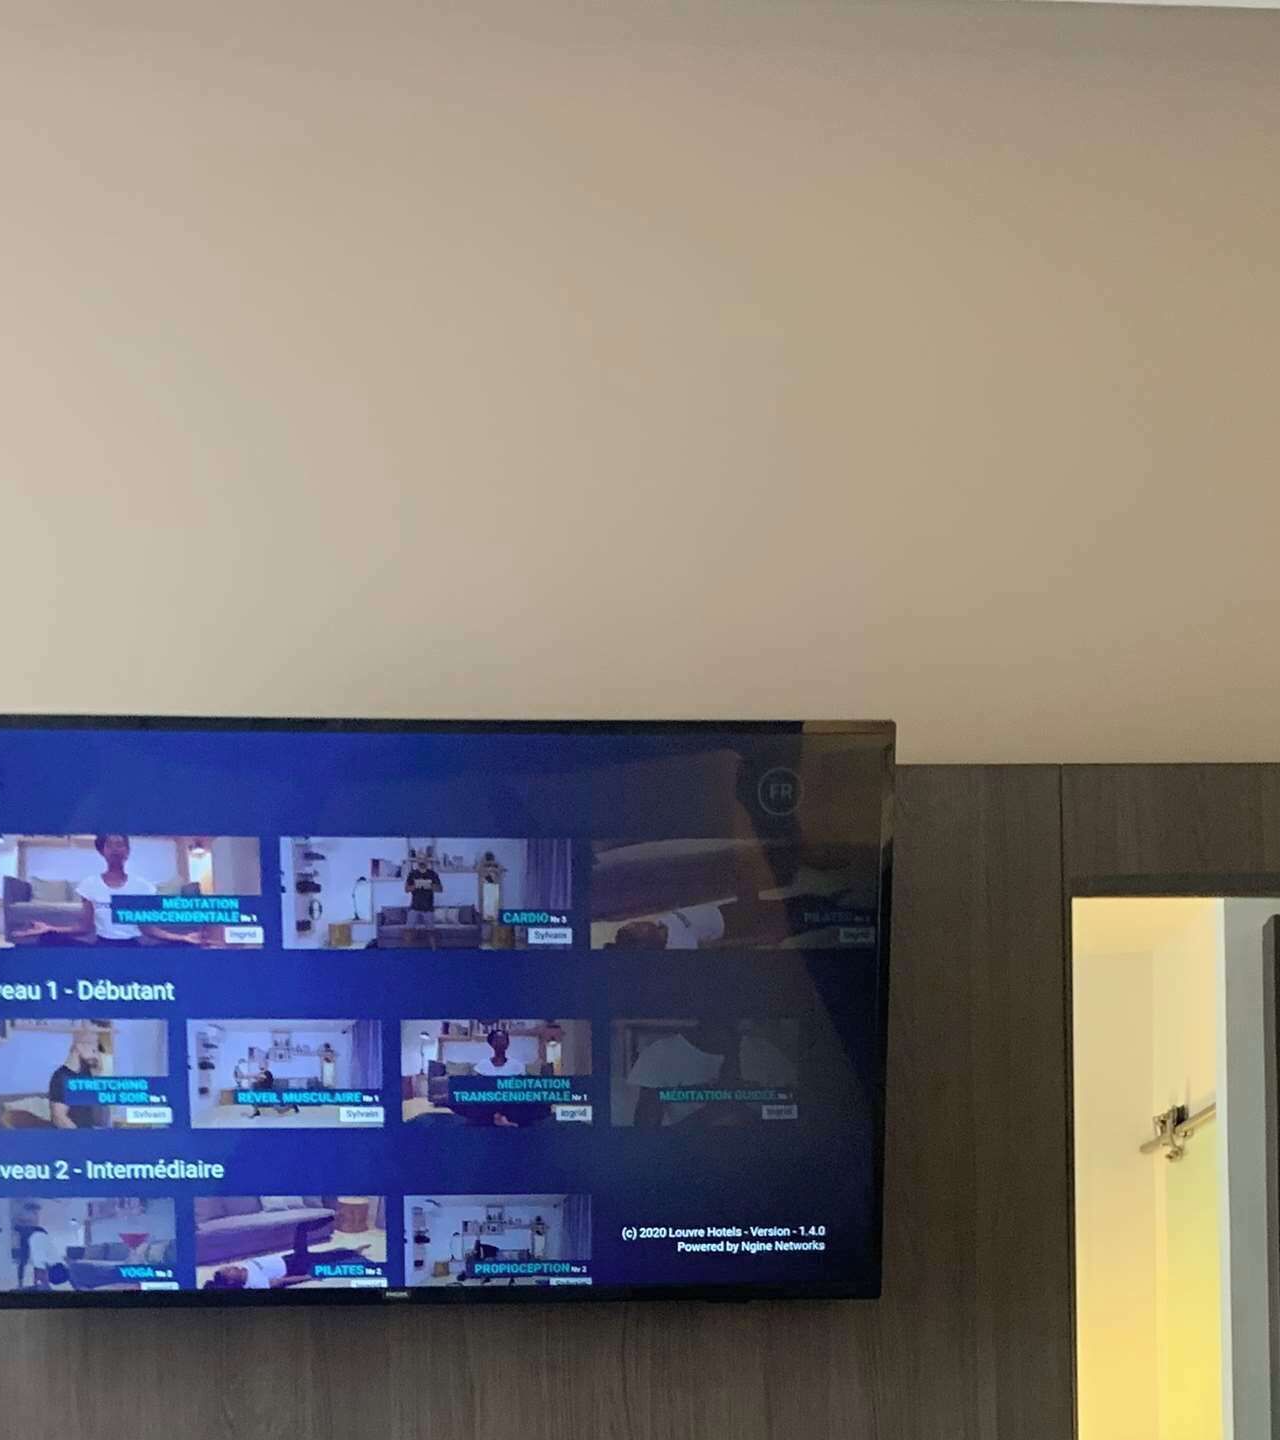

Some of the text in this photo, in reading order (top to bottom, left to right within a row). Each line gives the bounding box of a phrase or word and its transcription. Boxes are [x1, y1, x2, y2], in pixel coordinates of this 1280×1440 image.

[117, 911, 240, 923] TRANSCENDENTALE
[503, 912, 549, 923] CARDIO
[47, 981, 58, 1000] 1
[78, 980, 175, 1000] Débutant
[68, 1079, 148, 1091] STRETCHING
[497, 1078, 570, 1090] MÉDITATION
[98, 1092, 115, 1103] DU
[120, 1092, 149, 1103] SOIR
[282, 1091, 362, 1103] MUSCULAIRE
[454, 1091, 570, 1102] TRANSCENDENTALE
[56, 1160, 69, 1180] 2
[86, 1159, 224, 1180] Intermédiaire
[621, 1227, 637, 1240] (c)
[639, 1228, 667, 1238] 2020
[669, 1227, 705, 1238] Louvre
[707, 1227, 742, 1238] Hotels
[750, 1226, 791, 1237] Version
[799, 1225, 826, 1236] 1.4.0
[677, 1240, 825, 1254] Powered by Ngine Networks
[120, 1267, 154, 1278] YOGA
[315, 1265, 364, 1276] PILATES
[474, 1262, 570, 1274] PROPIOCEPTION
